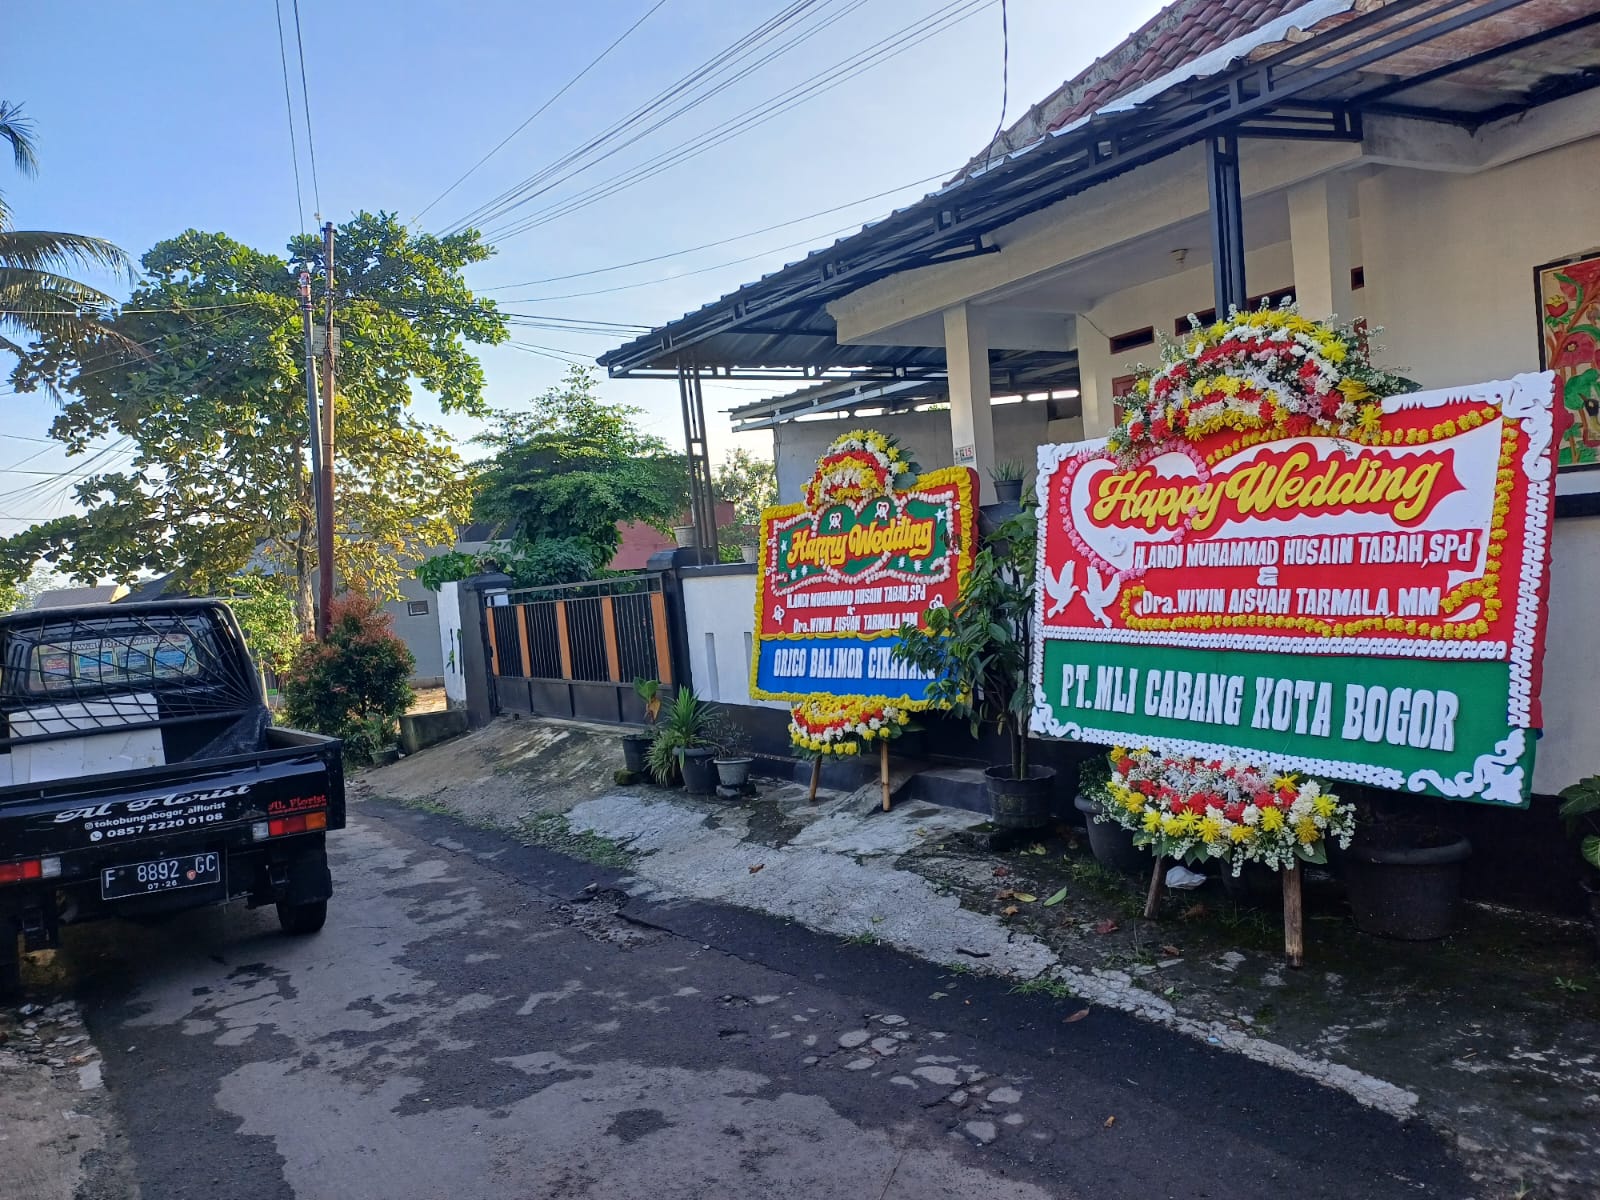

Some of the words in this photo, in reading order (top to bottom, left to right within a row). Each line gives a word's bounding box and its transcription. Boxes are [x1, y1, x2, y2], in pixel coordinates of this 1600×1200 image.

[1093, 471, 1226, 530] Happy
[1226, 451, 1443, 521] Wedding
[786, 529, 847, 566] Happy
[848, 515, 933, 558] Wedding
[1134, 544, 1184, 569] H.ANDI
[1186, 540, 1280, 567] MUHAMMAD
[1283, 536, 1354, 565] HUSAIN
[1358, 532, 1474, 568] TABAH,SPd
[811, 590, 854, 607] MUHAMMAD
[855, 588, 882, 604] HUSAIN
[1142, 588, 1226, 615] Dra.WIWIN
[1228, 589, 1292, 614] AISYAH
[1296, 588, 1393, 618] TARMALA,
[1398, 587, 1441, 617] MM
[773, 648, 807, 678] ORICO
[809, 647, 864, 679] BALIMOR
[1143, 669, 1245, 727] CABANG
[1250, 676, 1334, 738] KOTA
[1340, 683, 1460, 752] BOGOR
[127, 784, 251, 812] Florist
[106, 825, 144, 839] 0857
[148, 818, 185, 832] 2220
[188, 812, 223, 825] 0108
[105, 869, 116, 888] F
[137, 860, 180, 882] 8892
[195, 854, 216, 873] GC
